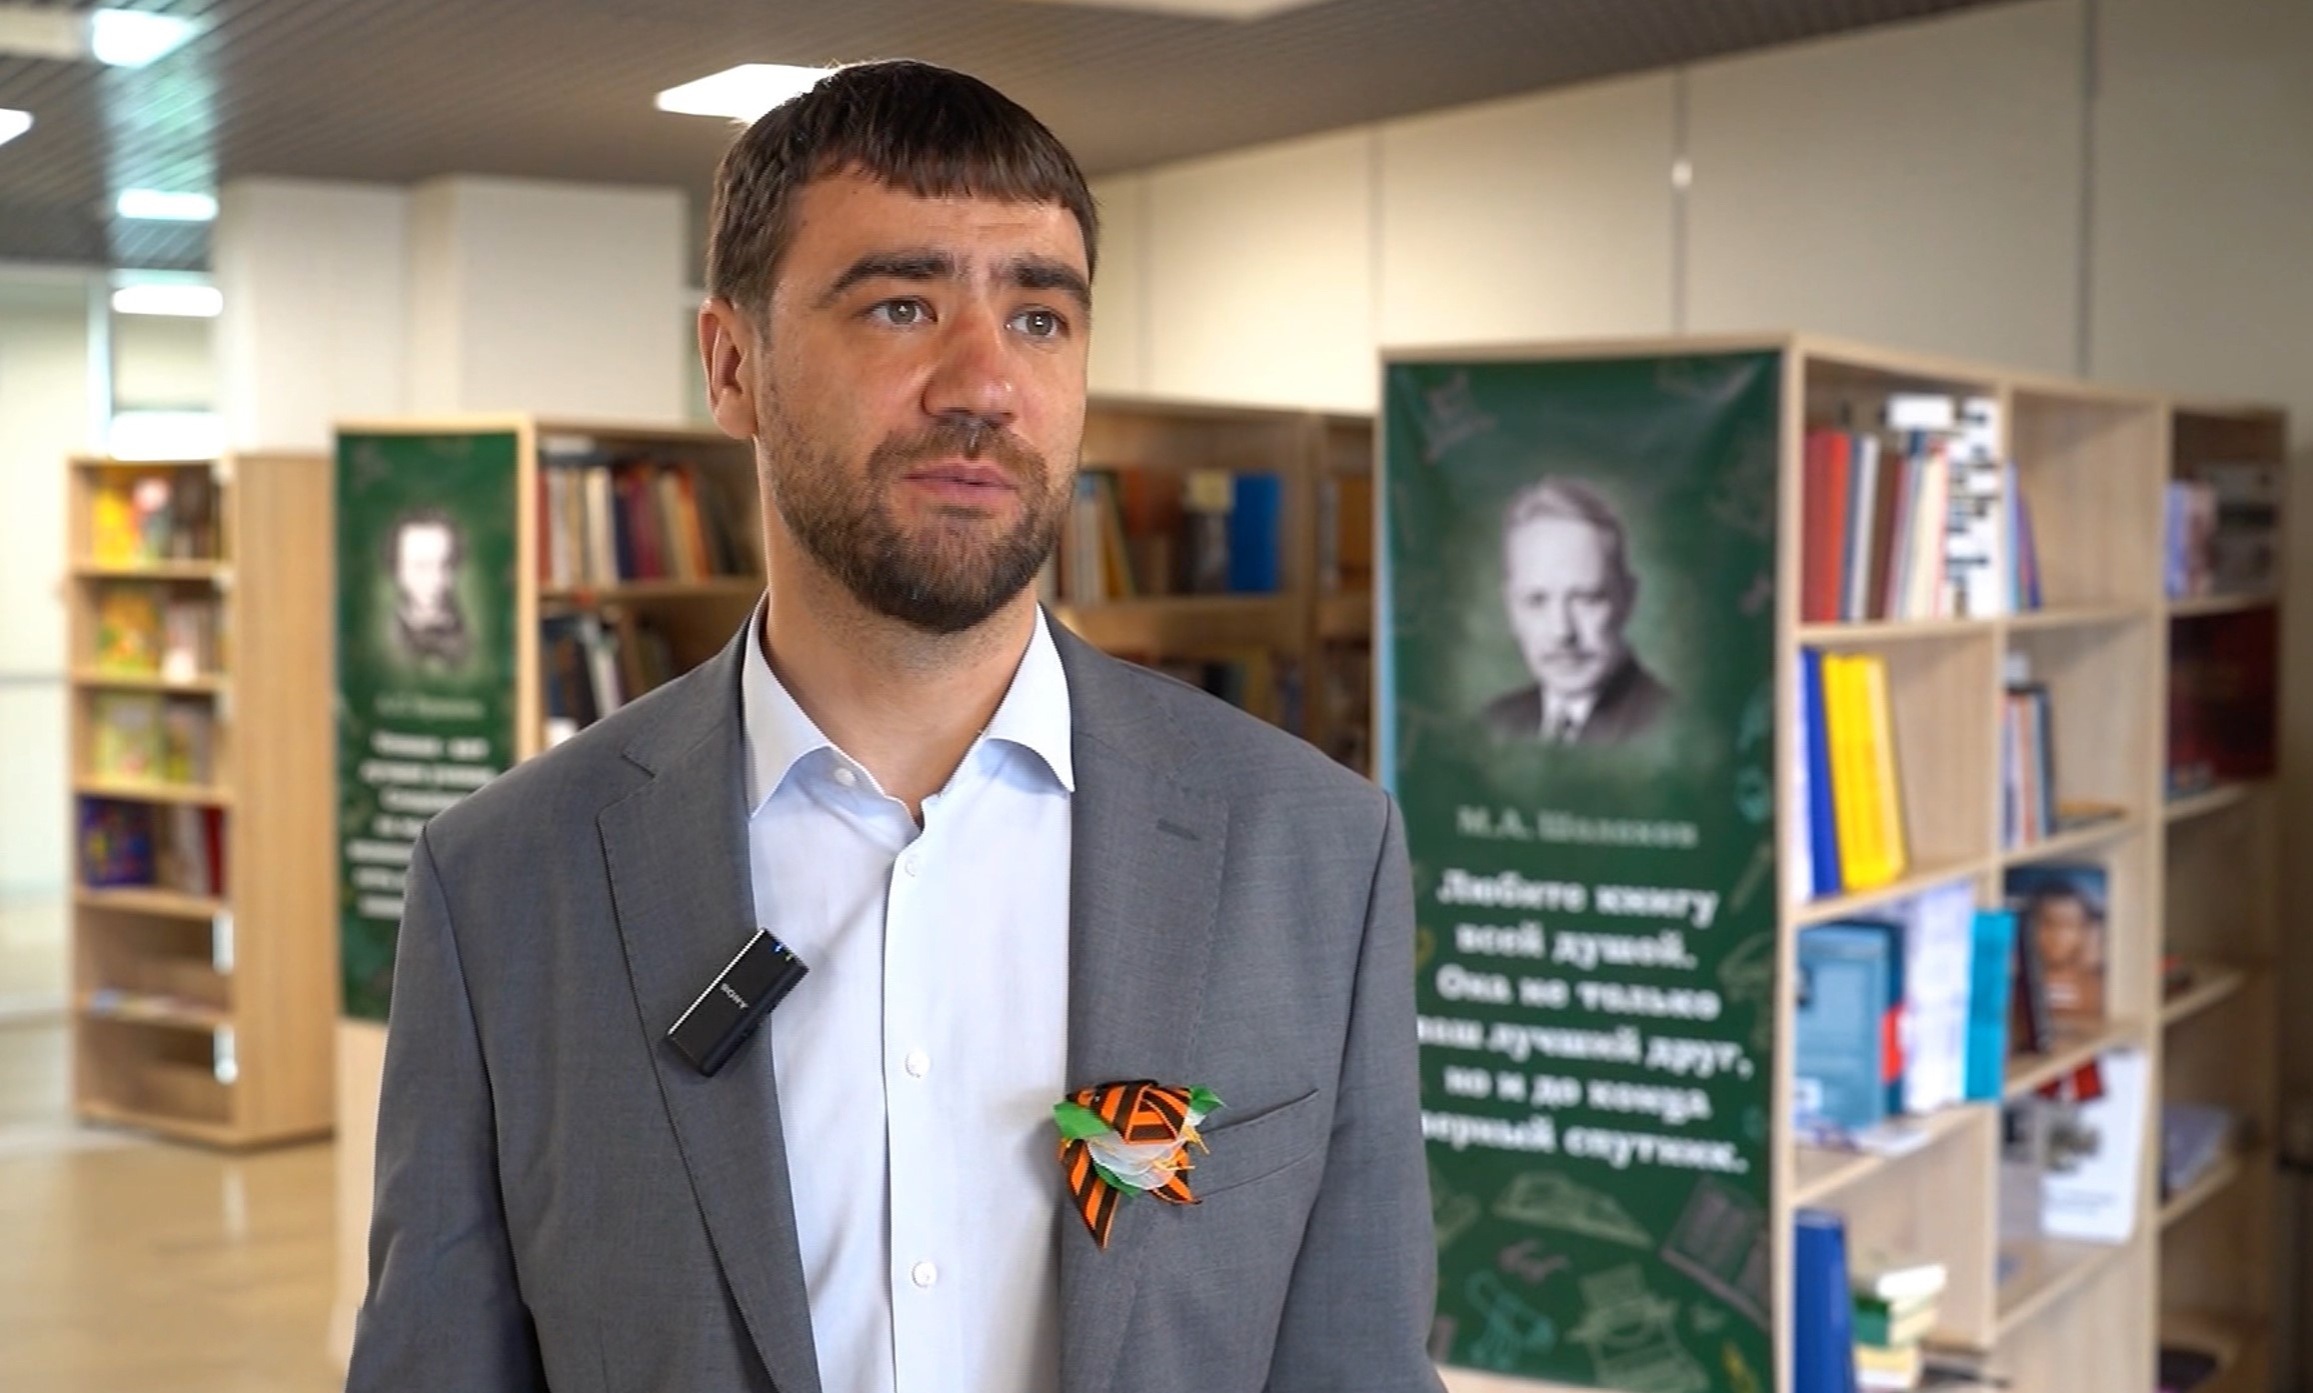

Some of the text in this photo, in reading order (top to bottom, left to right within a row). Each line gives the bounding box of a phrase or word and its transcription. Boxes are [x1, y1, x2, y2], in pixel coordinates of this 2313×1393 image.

[1436, 868, 1719, 929] Любите книгу
[1455, 921, 1699, 972] всей душой.
[720, 983, 749, 1009] SONY
[1436, 965, 1721, 1020] Она не только
[1487, 1022, 1640, 1063] лучший
[1444, 1068, 1711, 1125] но и до конца
